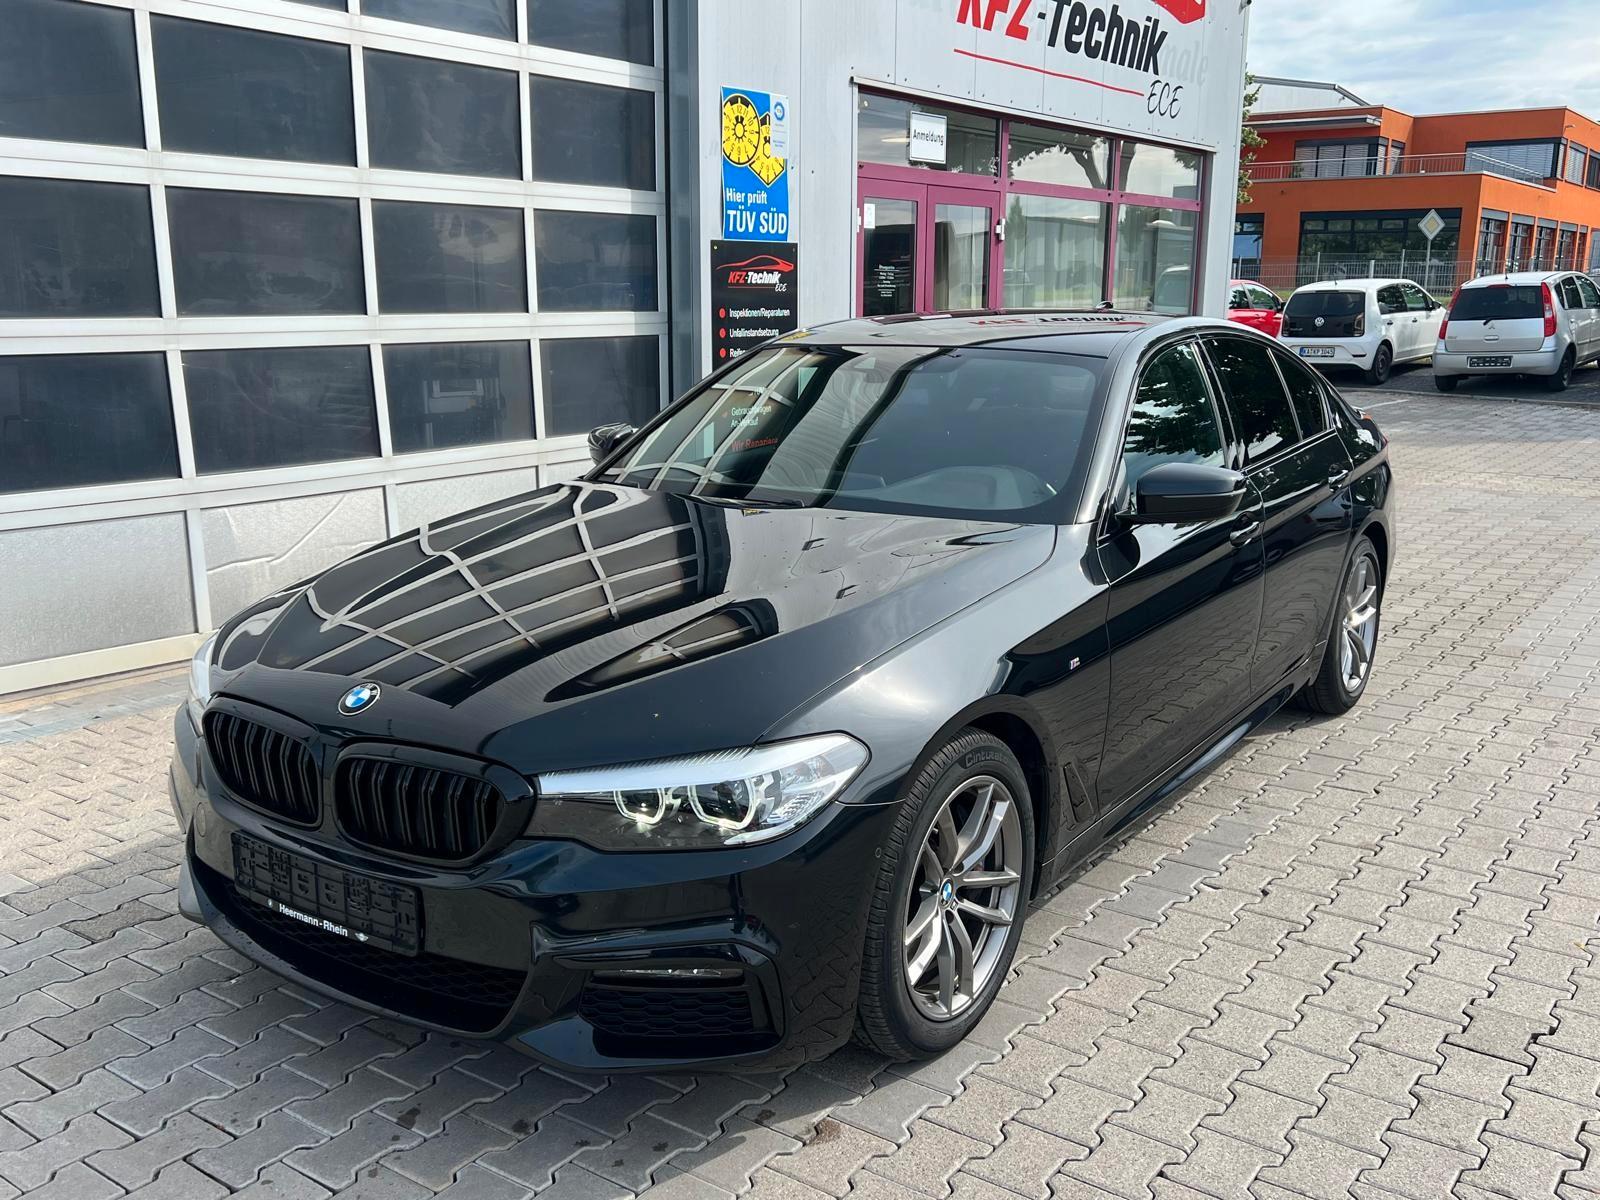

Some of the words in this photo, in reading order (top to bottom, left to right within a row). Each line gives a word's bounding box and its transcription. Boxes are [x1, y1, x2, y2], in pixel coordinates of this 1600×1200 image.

[1147, 80, 1184, 119] ECE
[912, 129, 945, 146] Anmeldung
[726, 187, 746, 203] Hier
[747, 190, 768, 207] prüft
[727, 204, 757, 233] TÜV
[759, 207, 788, 235] SÜD
[728, 271, 782, 284] KFZ-Technik
[729, 308, 791, 319] Inspektionen/Reparaturen
[729, 328, 779, 338] Unfallinstandsetzung
[279, 903, 349, 937] Heermann-Rhein
